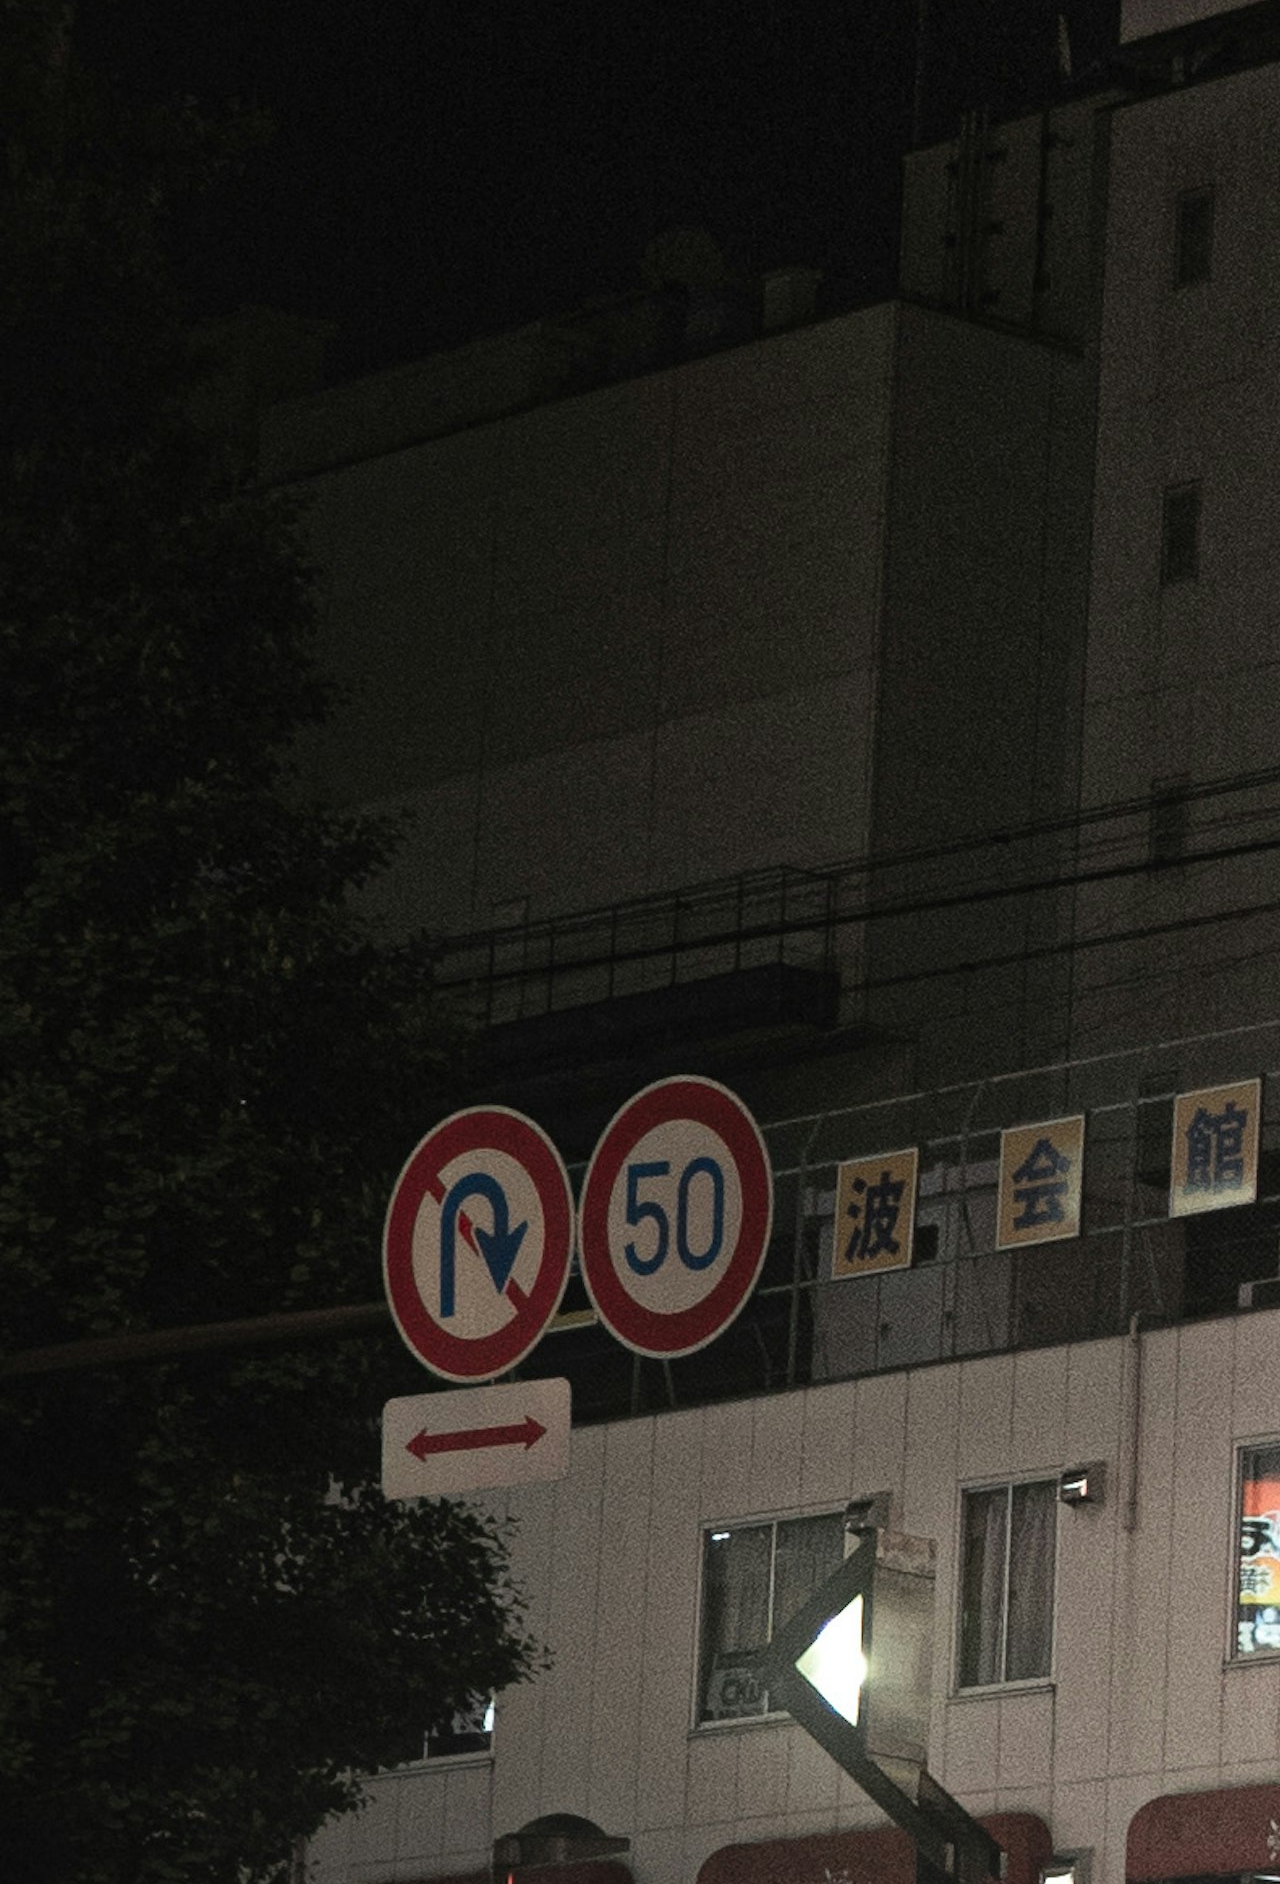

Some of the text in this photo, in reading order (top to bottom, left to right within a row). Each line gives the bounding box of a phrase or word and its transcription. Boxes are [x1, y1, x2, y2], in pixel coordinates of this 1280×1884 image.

[624, 1156, 724, 1277] 50
[845, 1101, 1248, 1263] 波 会 館
